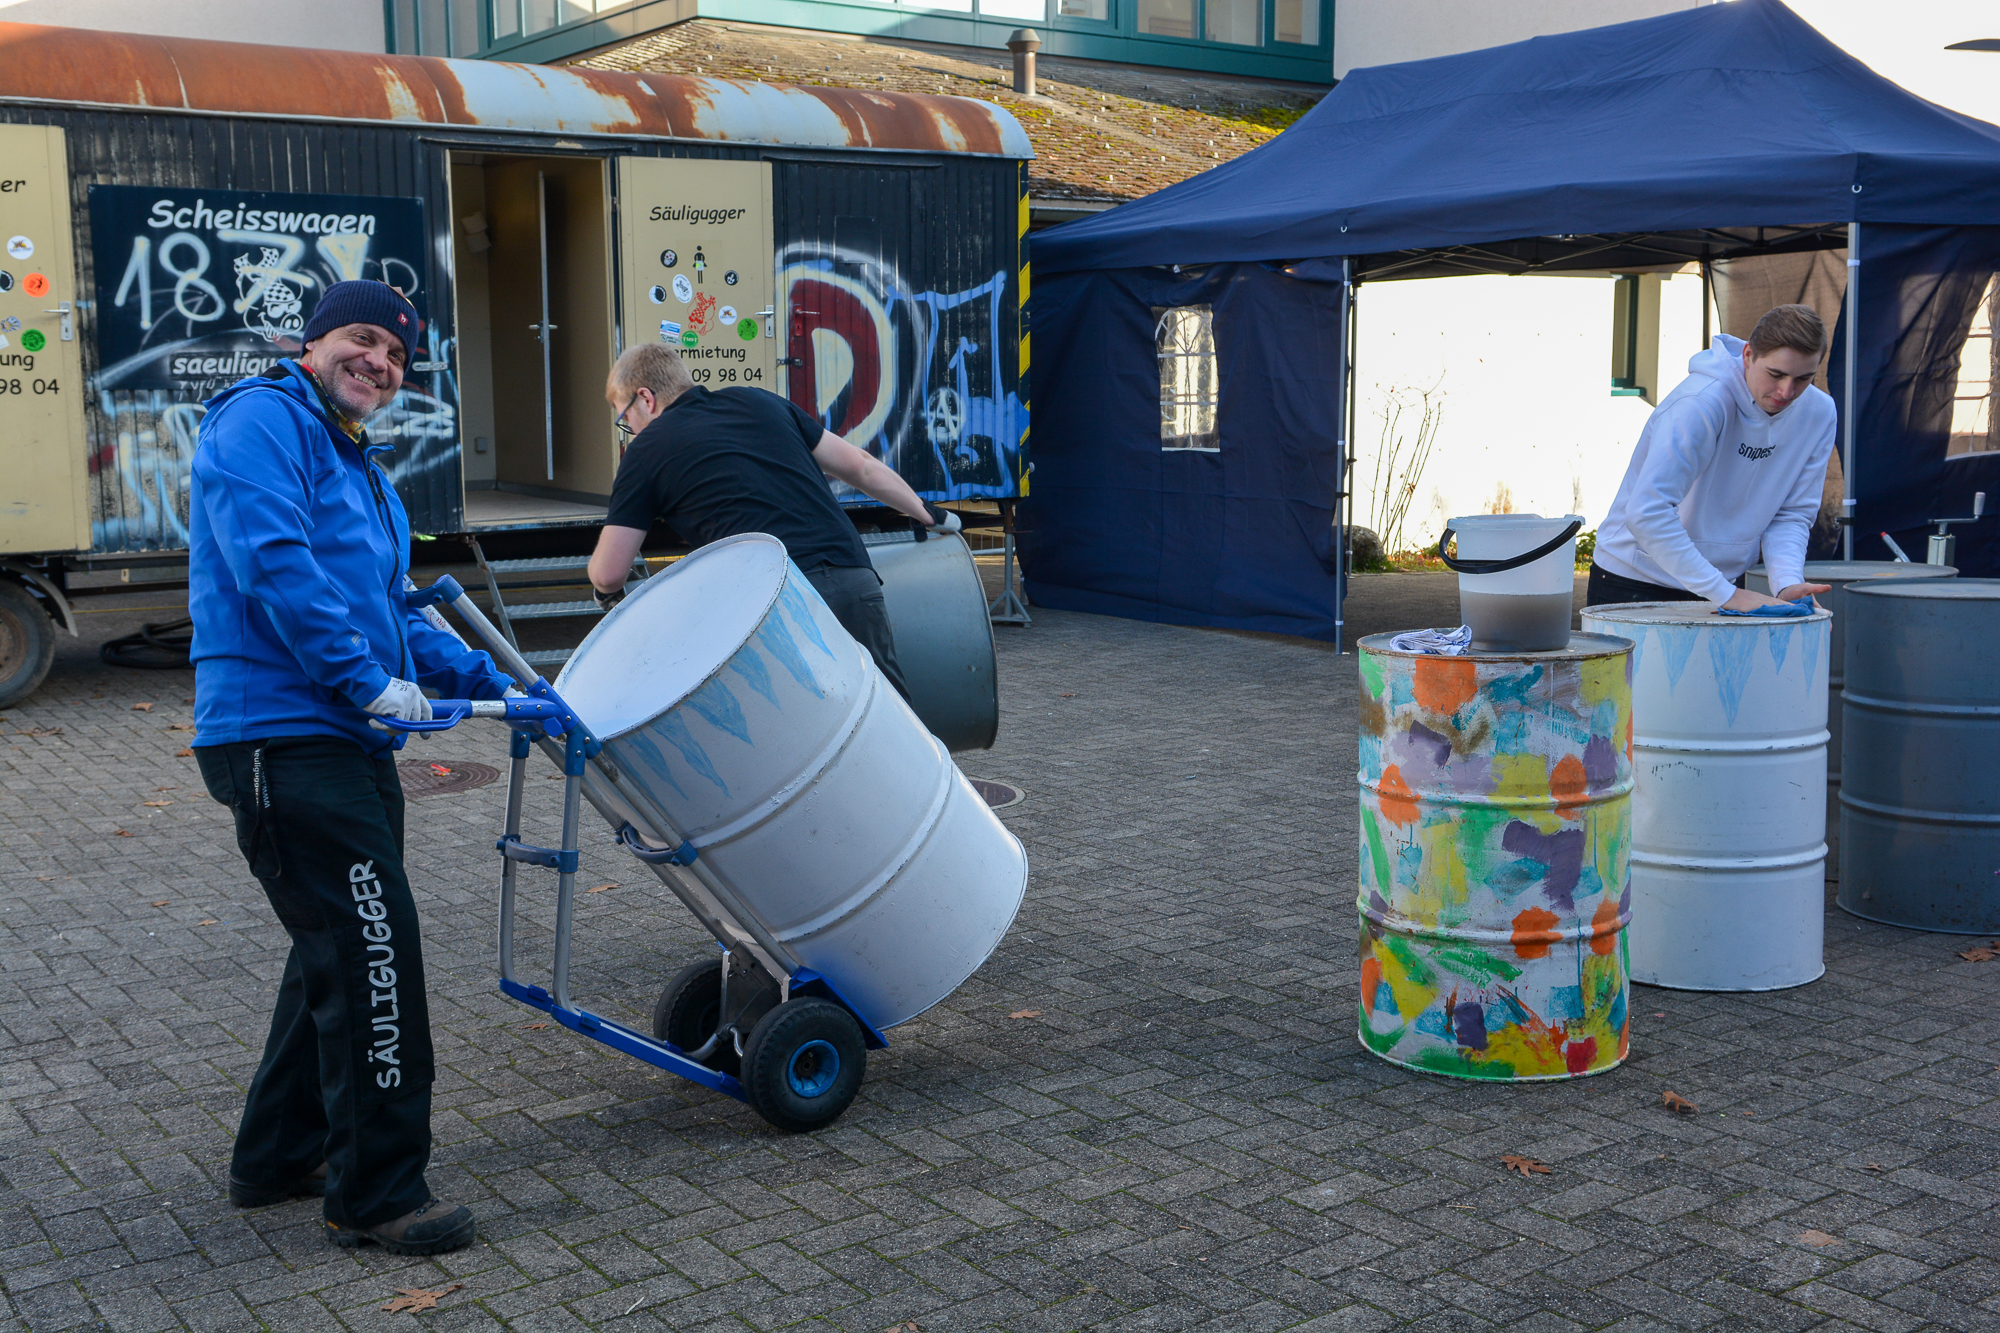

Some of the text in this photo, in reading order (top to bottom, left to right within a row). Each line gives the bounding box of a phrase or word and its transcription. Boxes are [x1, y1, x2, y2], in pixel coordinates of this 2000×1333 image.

[0, 179, 27, 193] er
[148, 198, 376, 236] Scheisswagen
[649, 204, 746, 225] Säuligugger
[0, 353, 35, 371] ung
[172, 350, 279, 380] saeuligu
[691, 367, 763, 383] 09 98 04
[0, 378, 60, 395] 98 04
[349, 859, 402, 1089] SÄULIGUGGER
